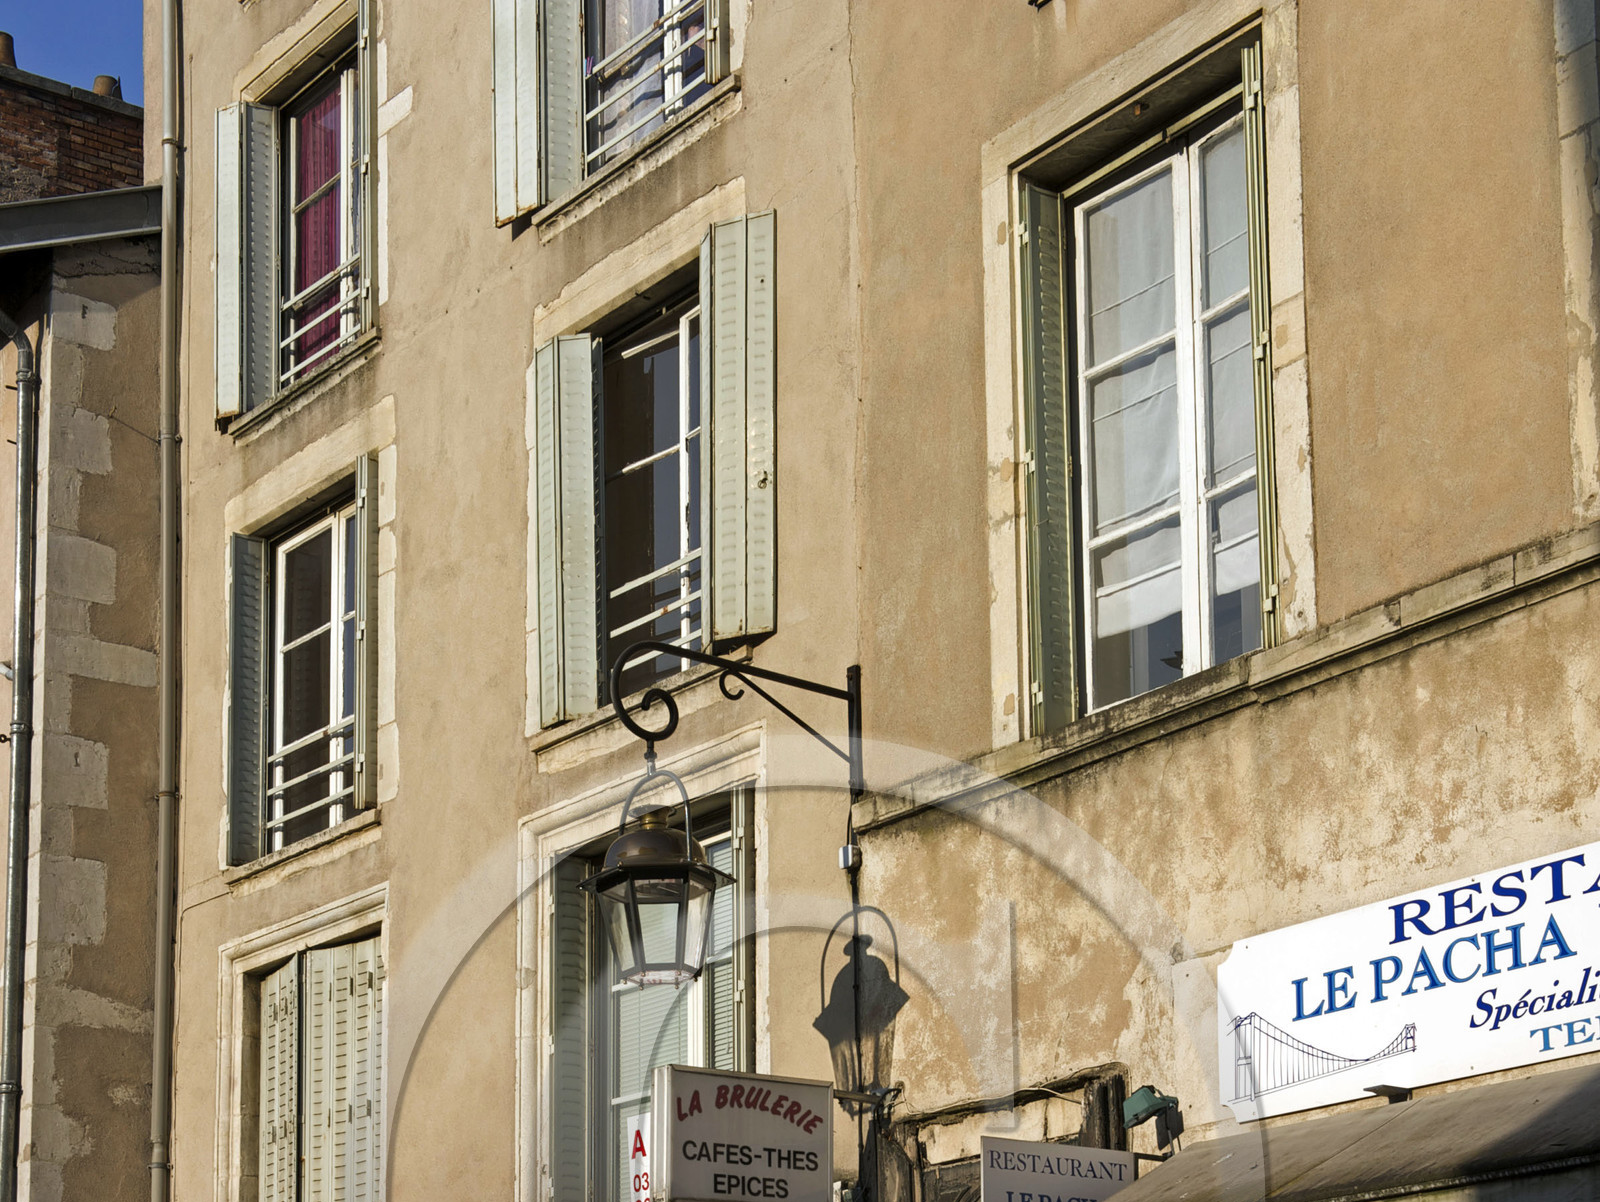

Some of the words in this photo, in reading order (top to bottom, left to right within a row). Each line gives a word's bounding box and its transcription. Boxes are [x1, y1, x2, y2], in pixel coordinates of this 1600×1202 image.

[1291, 966, 1358, 1022] LE
[1369, 913, 1577, 1004] PACHA
[1469, 966, 1600, 1031] Spéciali
[1529, 1016, 1600, 1053] TE
[676, 1089, 703, 1122] LA
[715, 1084, 824, 1135] BRULERIE
[682, 1140, 819, 1171] CAFES-THES
[989, 1150, 1128, 1181] RESTAURANT
[633, 1172, 650, 1193] 03
[713, 1173, 789, 1199] EPICES
